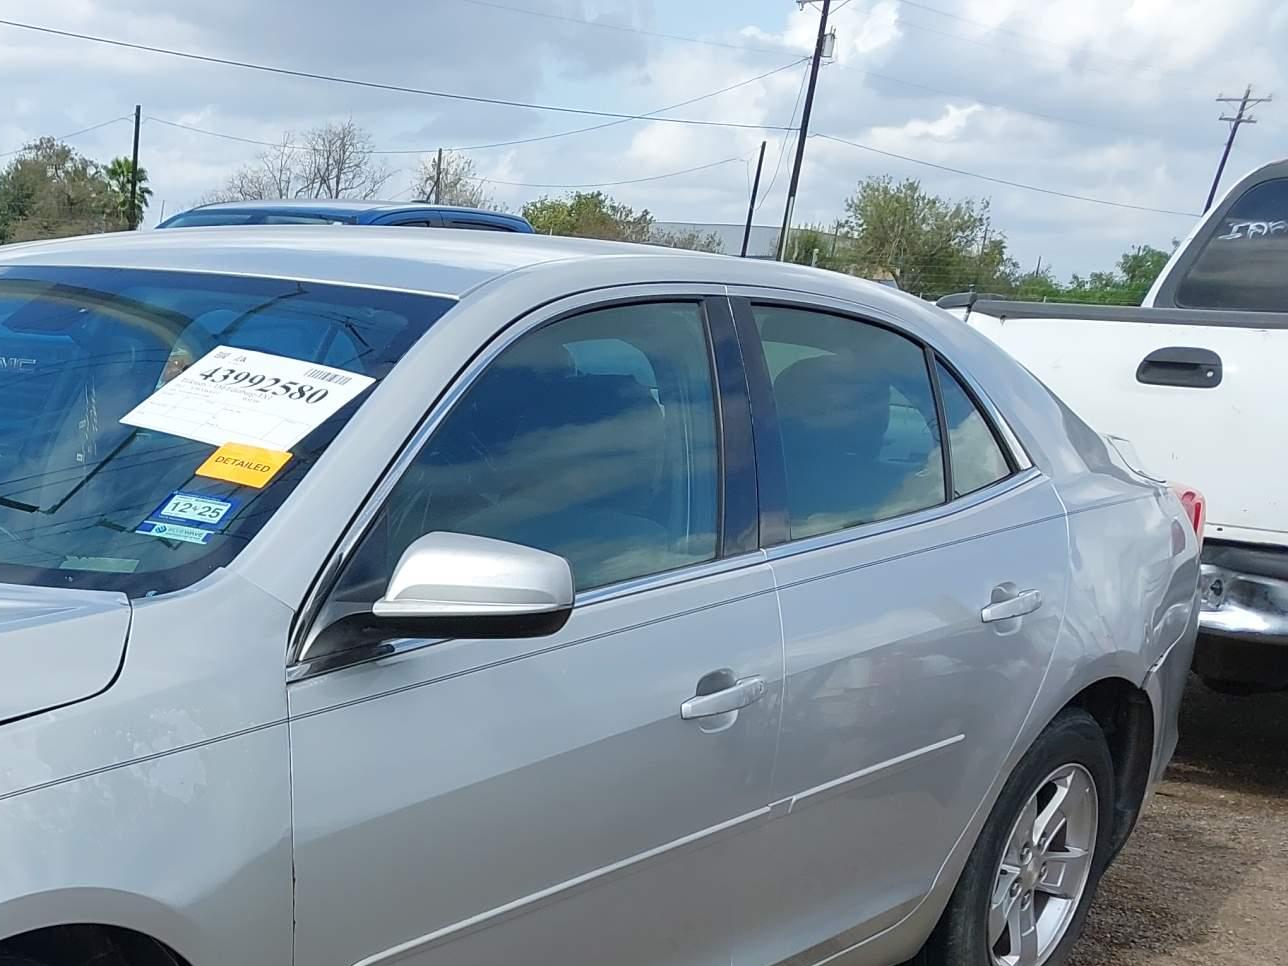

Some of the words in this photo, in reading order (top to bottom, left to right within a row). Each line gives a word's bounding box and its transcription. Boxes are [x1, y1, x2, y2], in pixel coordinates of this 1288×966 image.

[199, 366, 330, 404] 43992580
[214, 455, 271, 473] DETAILED
[171, 501, 192, 513] 12
[197, 505, 223, 519] 25
